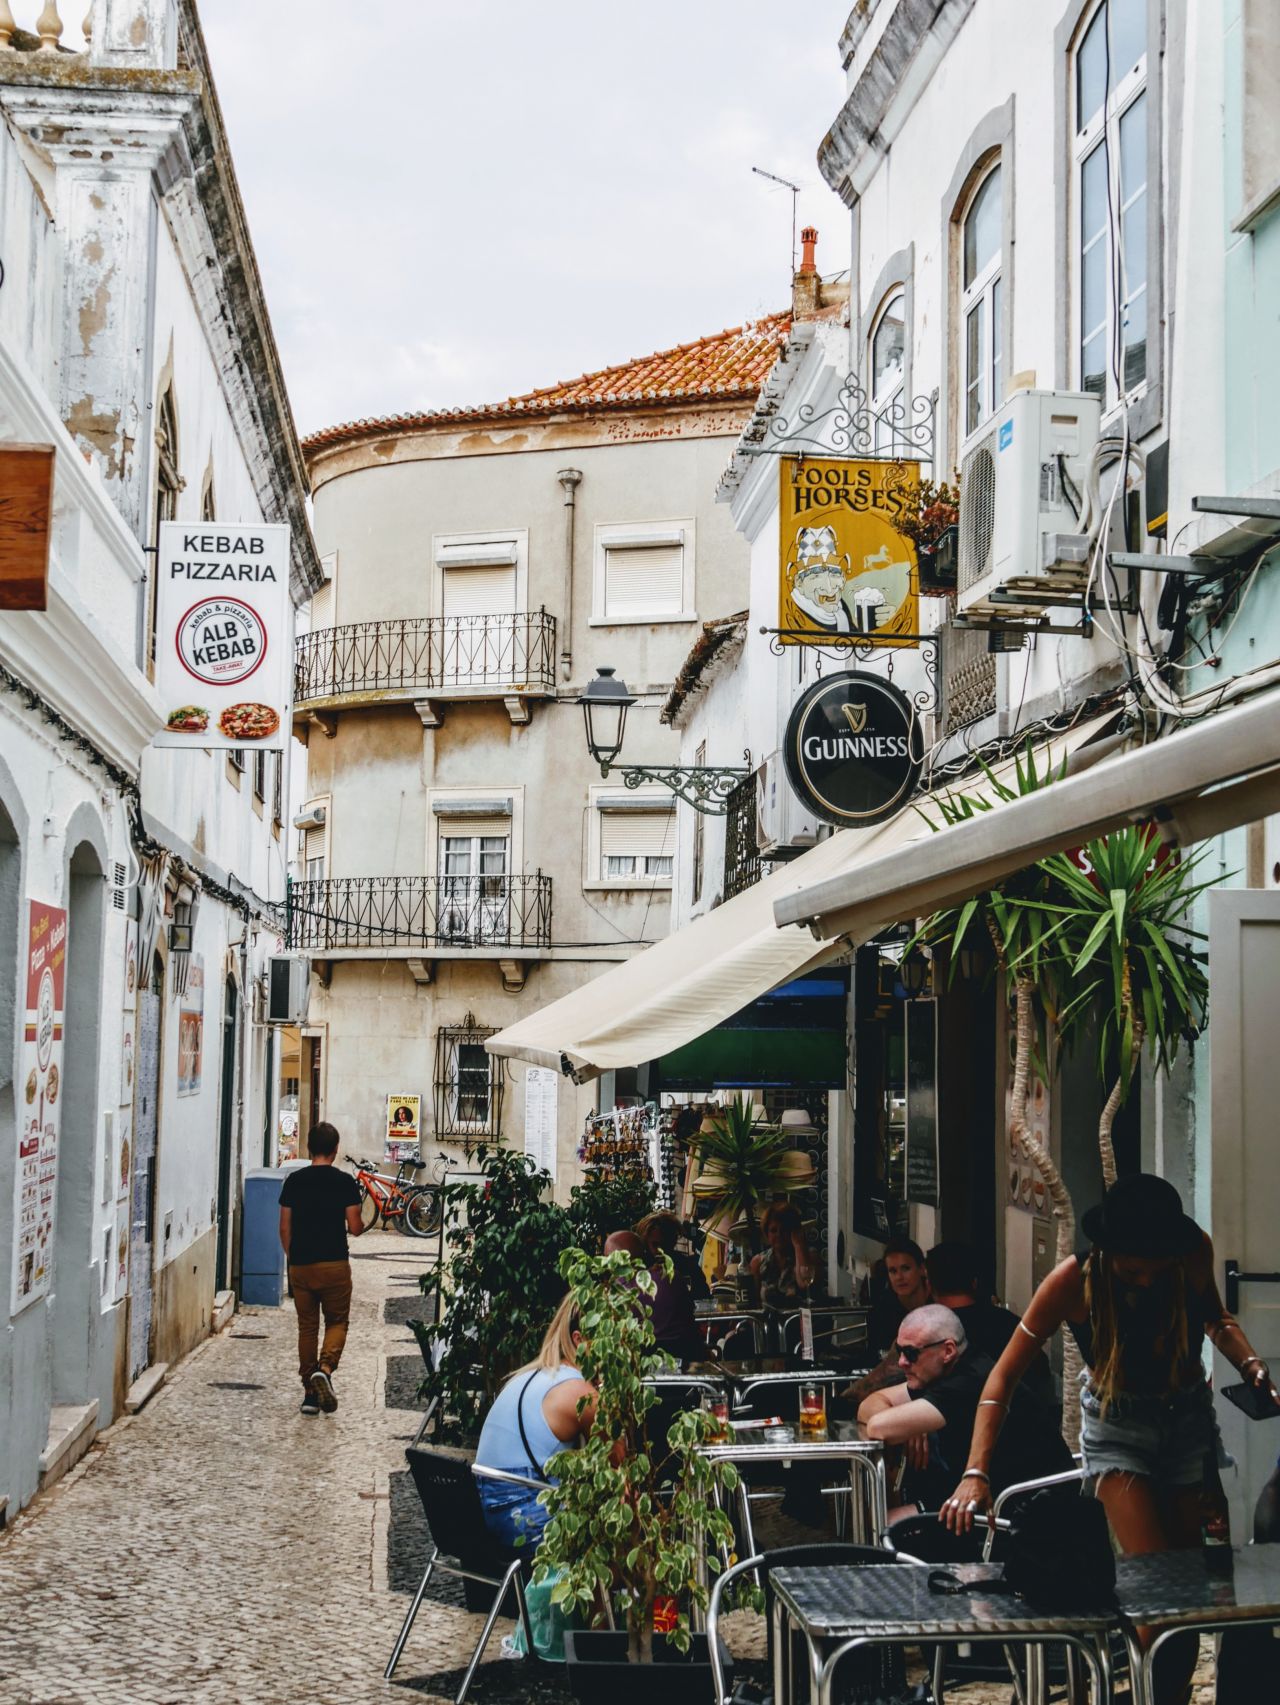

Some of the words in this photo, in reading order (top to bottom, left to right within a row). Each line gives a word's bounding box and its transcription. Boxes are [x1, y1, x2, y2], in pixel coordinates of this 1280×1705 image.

[791, 466, 872, 486] FOOLS
[793, 486, 903, 516] HORSES
[183, 534, 265, 555] KEBAB
[170, 561, 277, 583] PIZZARIA
[189, 606, 213, 629] kebab
[214, 604, 222, 612] &
[224, 605, 254, 629] pizzaria
[202, 621, 238, 645] ALB
[192, 637, 256, 666] KEBAB
[803, 736, 908, 761] GUINNESS
